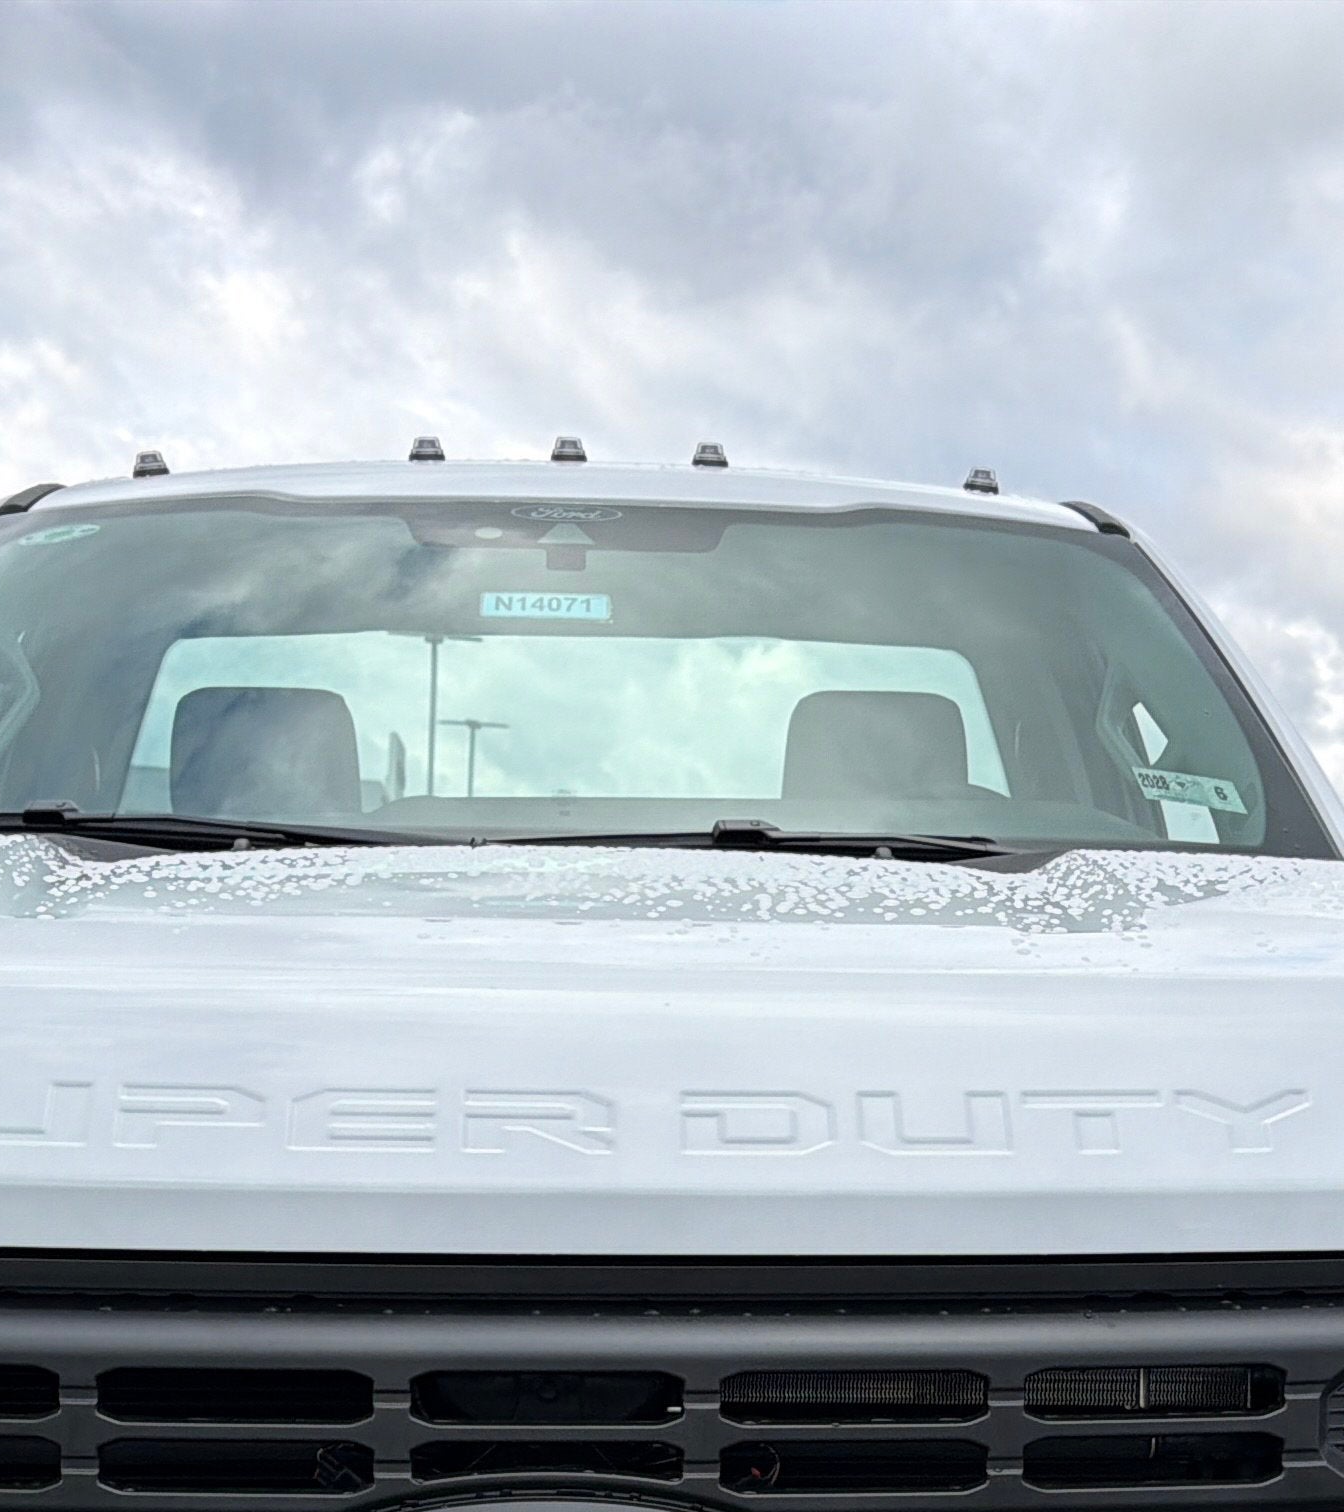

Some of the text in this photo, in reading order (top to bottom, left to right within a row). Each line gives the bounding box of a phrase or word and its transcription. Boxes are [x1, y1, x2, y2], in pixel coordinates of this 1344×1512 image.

[530, 506, 604, 519] Ford
[494, 595, 592, 612] N14071
[678, 1088, 1312, 1156] DUTY
